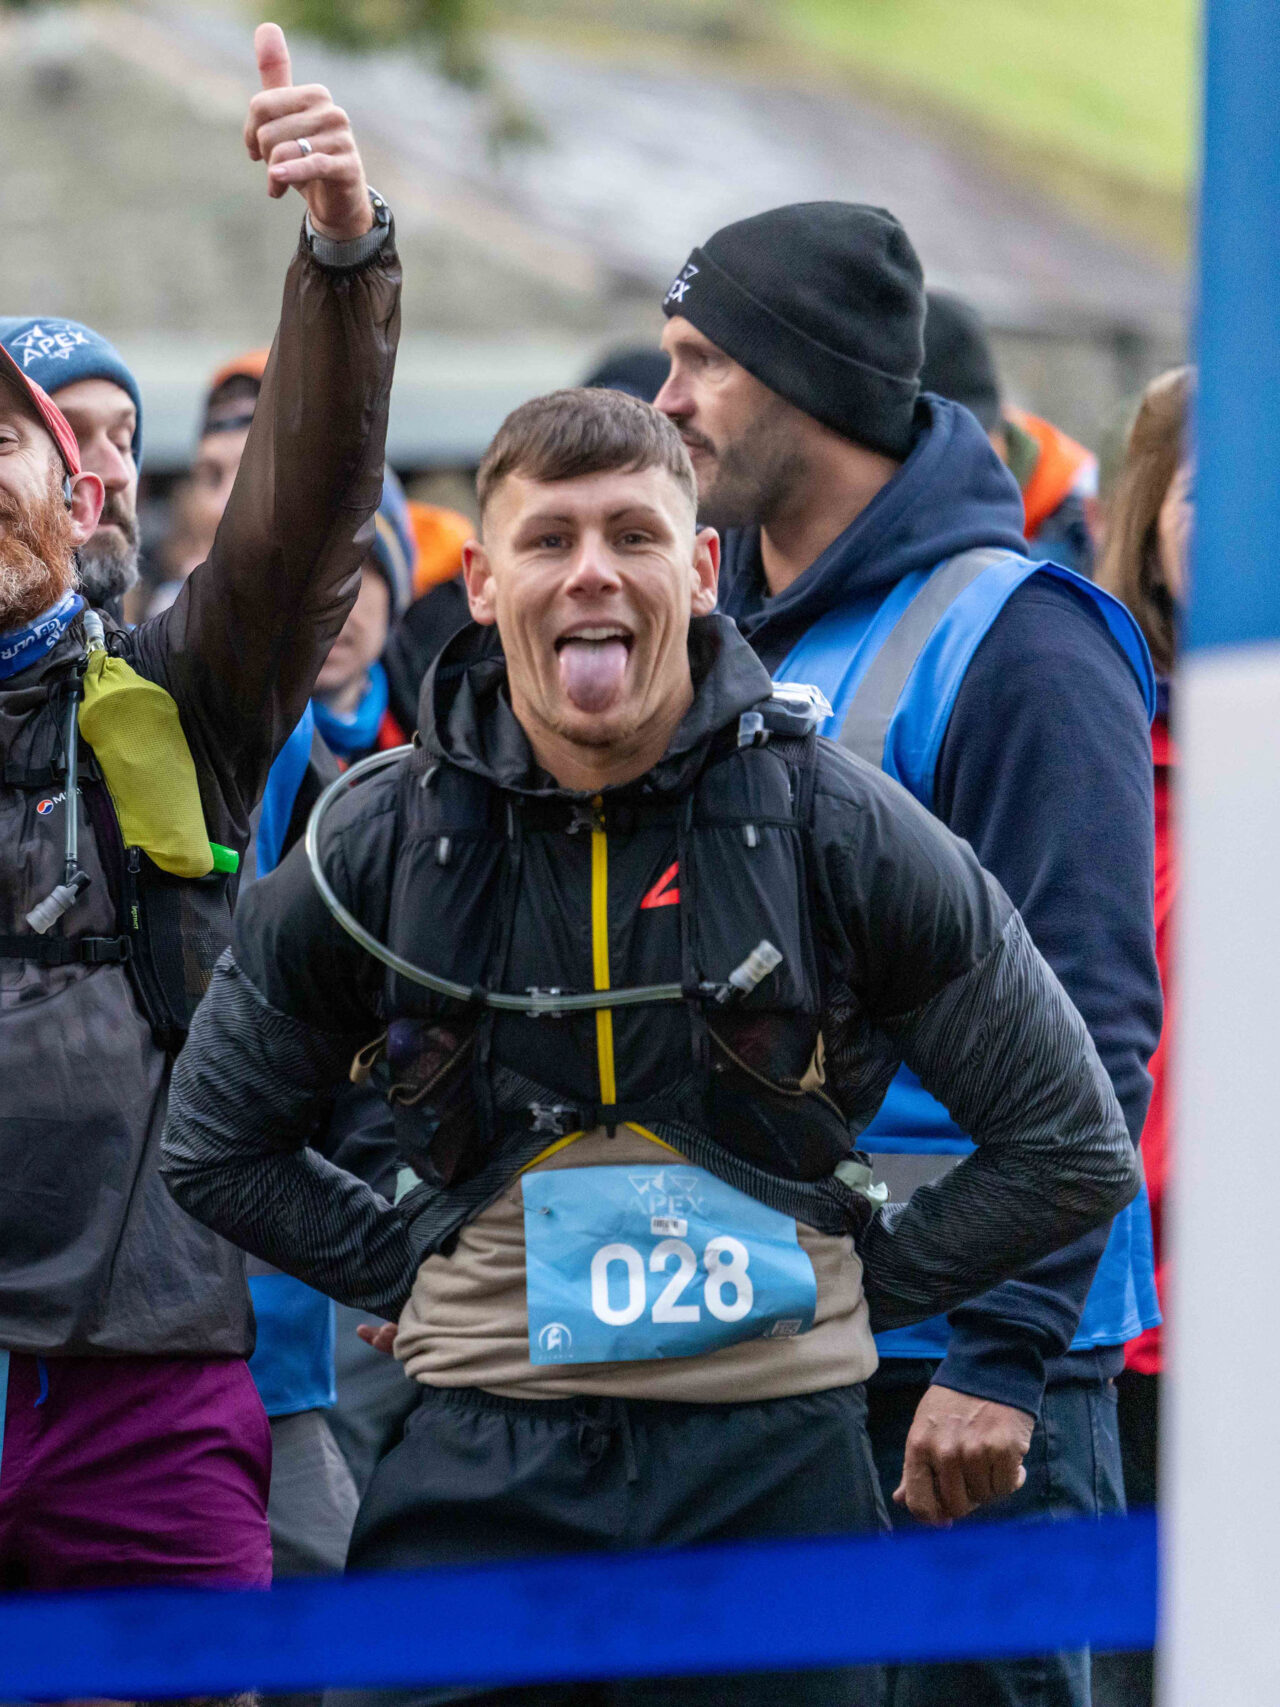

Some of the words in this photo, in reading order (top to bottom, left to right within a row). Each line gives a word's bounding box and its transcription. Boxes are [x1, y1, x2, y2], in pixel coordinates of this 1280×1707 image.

[23, 325, 90, 367] APEX
[629, 1193, 706, 1215] APEX
[591, 1236, 753, 1326] 028
